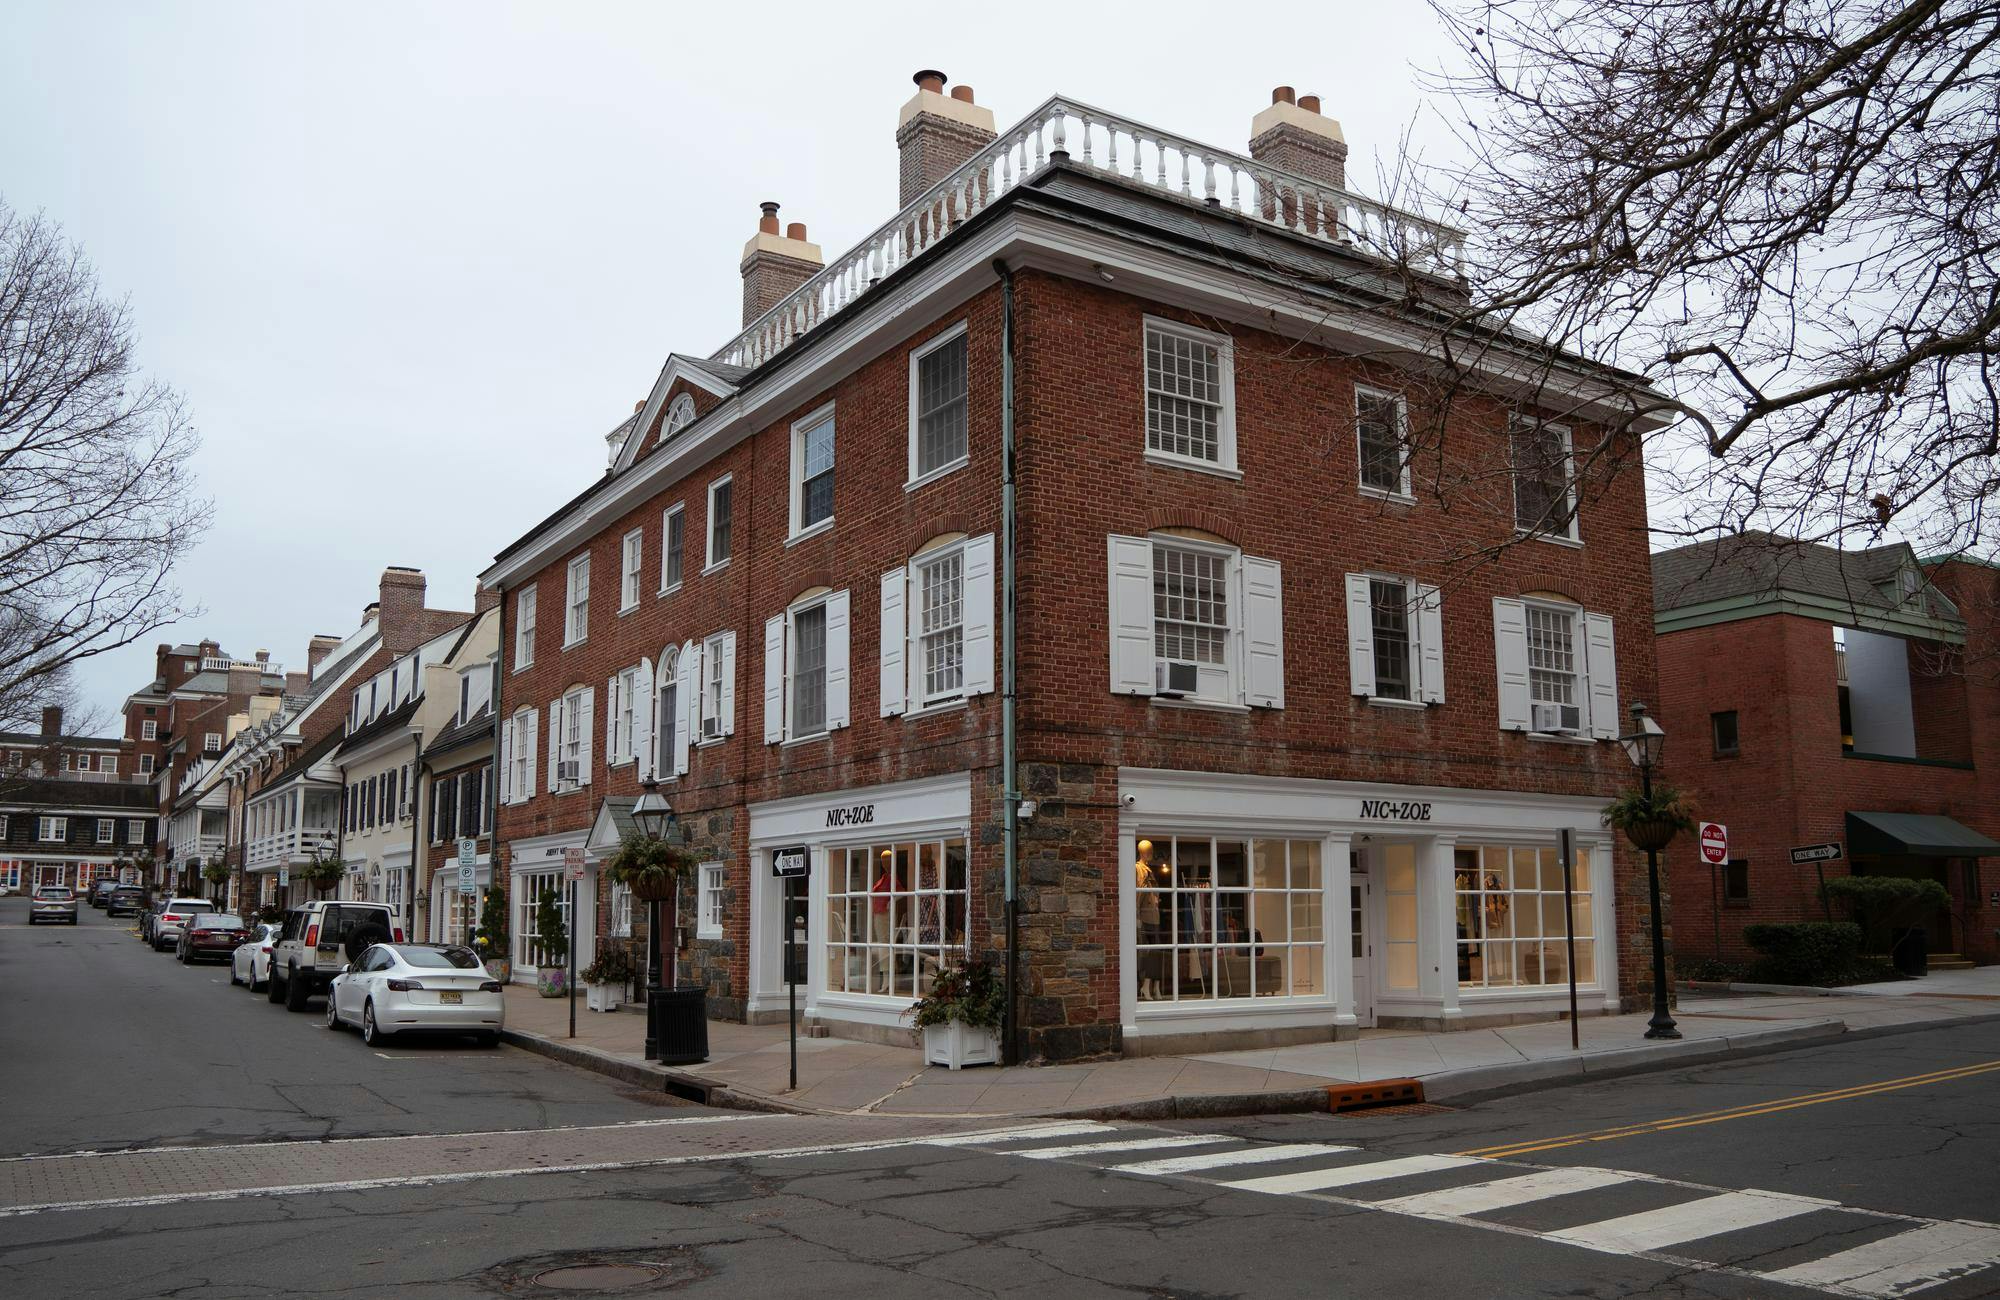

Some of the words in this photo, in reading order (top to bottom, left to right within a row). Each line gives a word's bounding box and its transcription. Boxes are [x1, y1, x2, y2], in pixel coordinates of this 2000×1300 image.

[826, 804, 875, 827] NIC+ZOE
[1360, 800, 1432, 820] NIC+ZOE
[782, 857, 792, 868] ONE
[793, 855, 803, 867] WAY
[1795, 851, 1810, 860] ONE
[1814, 848, 1830, 857] WAY
